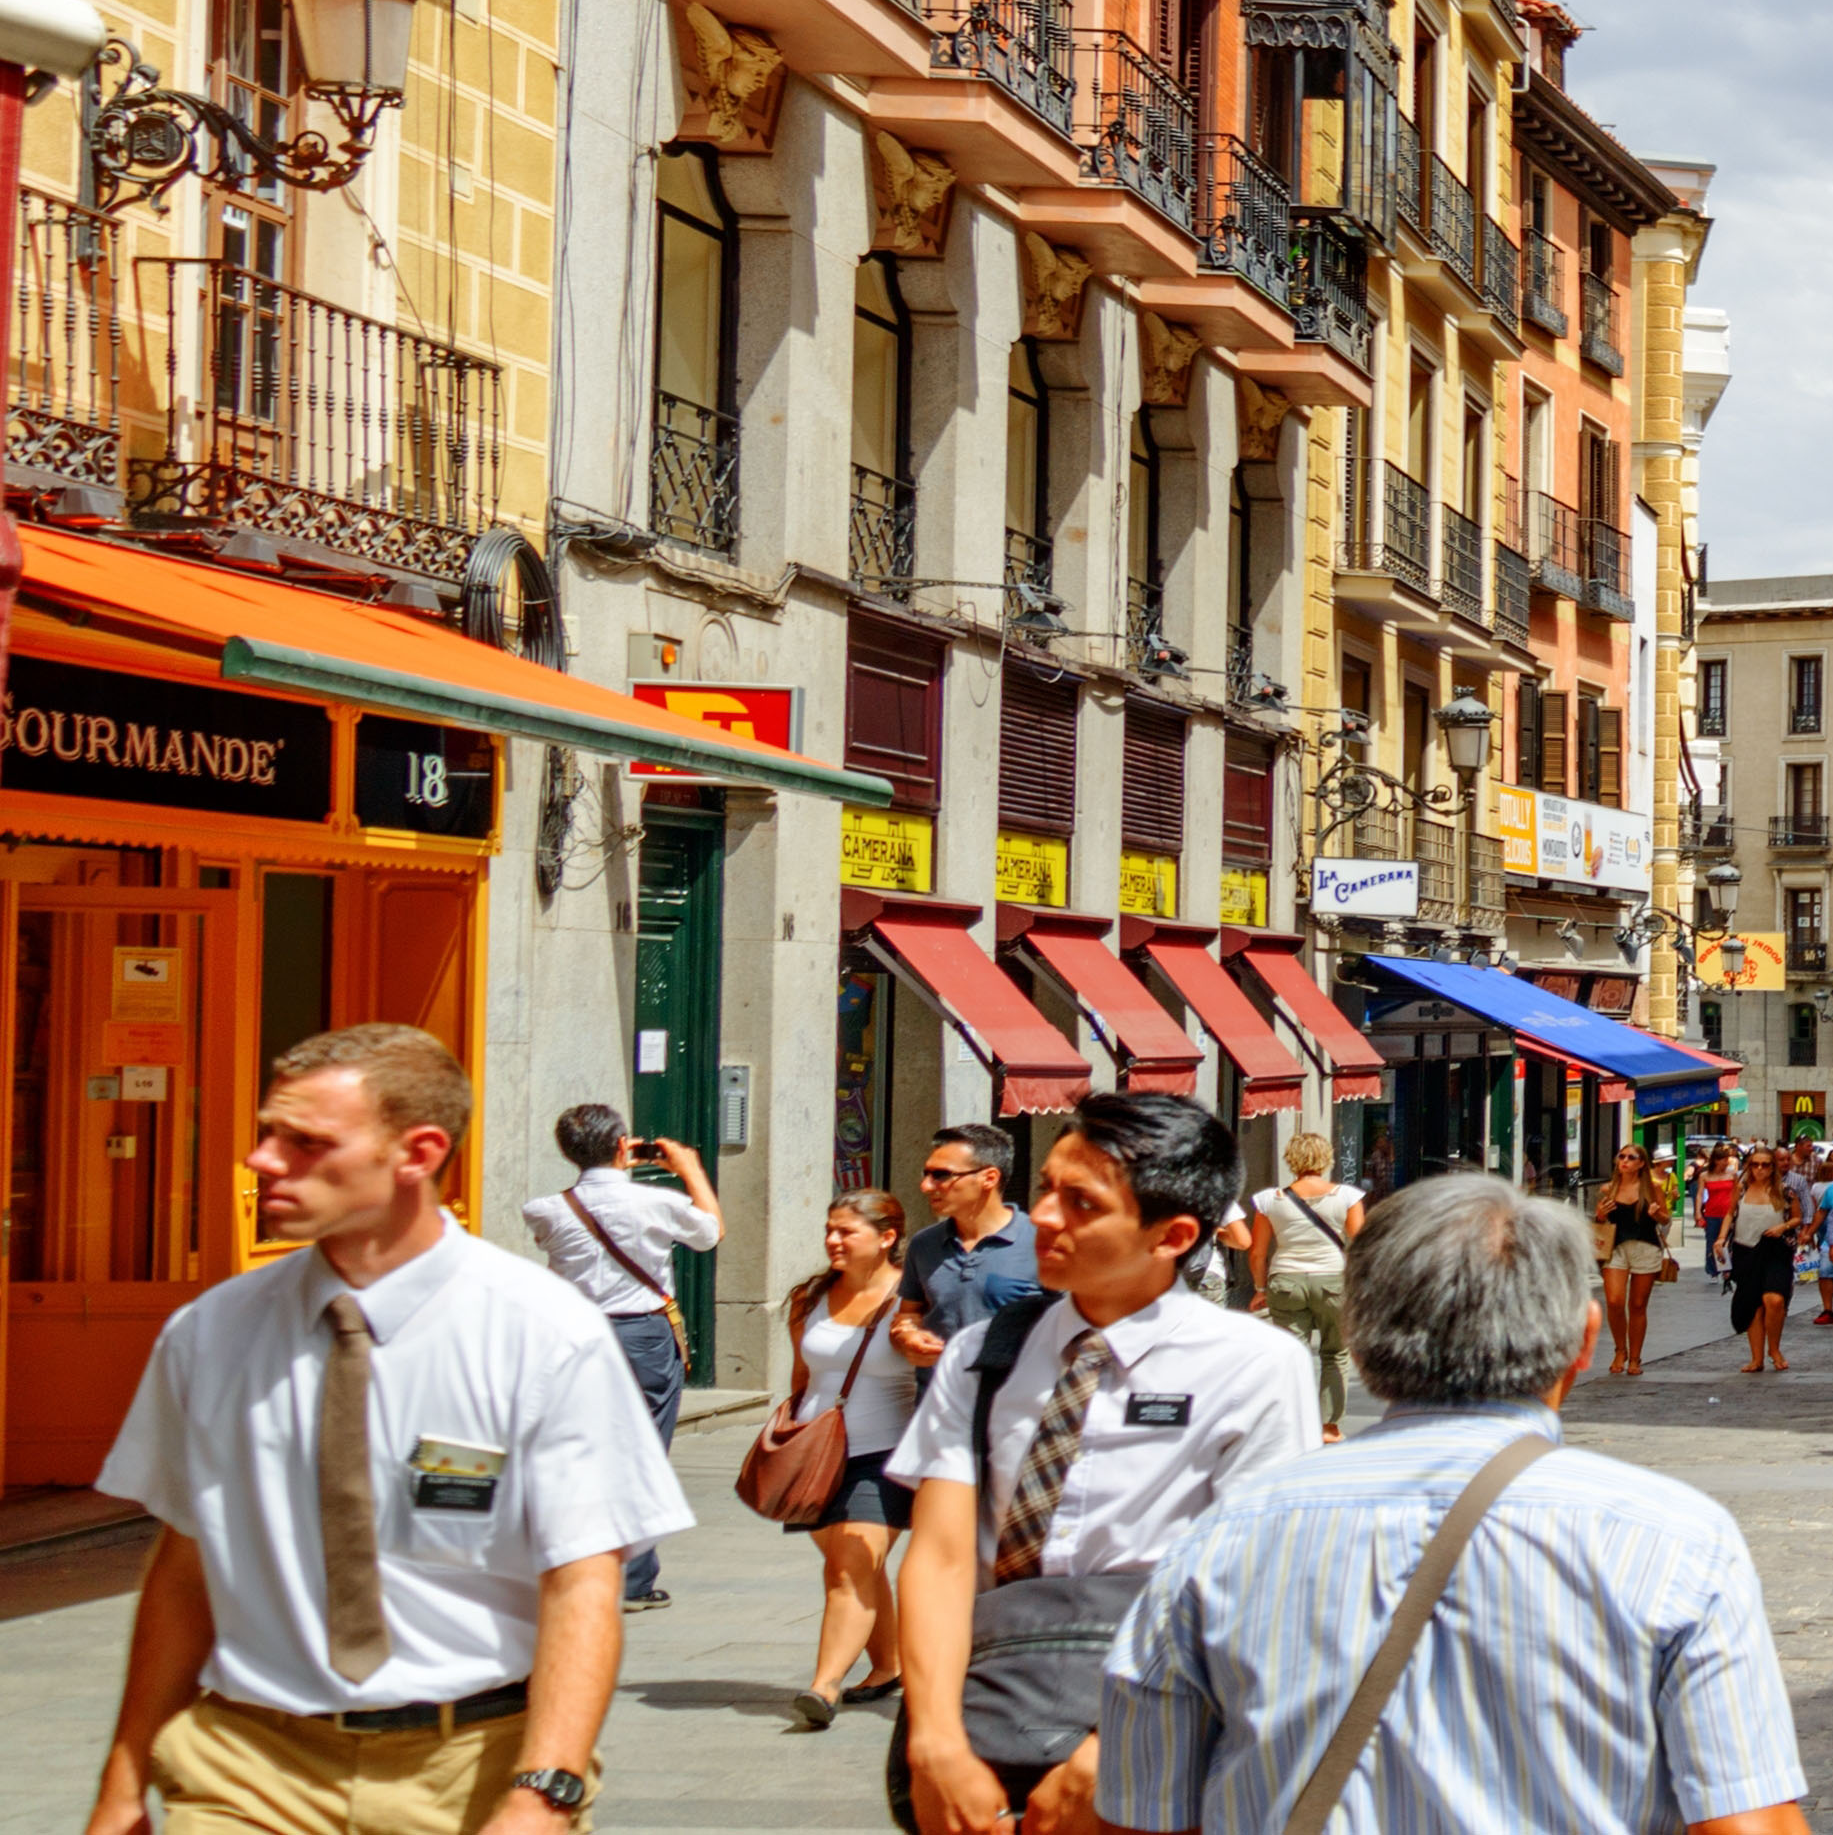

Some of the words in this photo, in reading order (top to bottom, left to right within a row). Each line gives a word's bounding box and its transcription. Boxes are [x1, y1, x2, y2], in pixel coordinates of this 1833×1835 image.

[404, 751, 449, 807] 18
[842, 834, 916, 867] CAMERANA
[996, 855, 1053, 884] CAMERANA
[1334, 869, 1414, 903] CAMERANA
